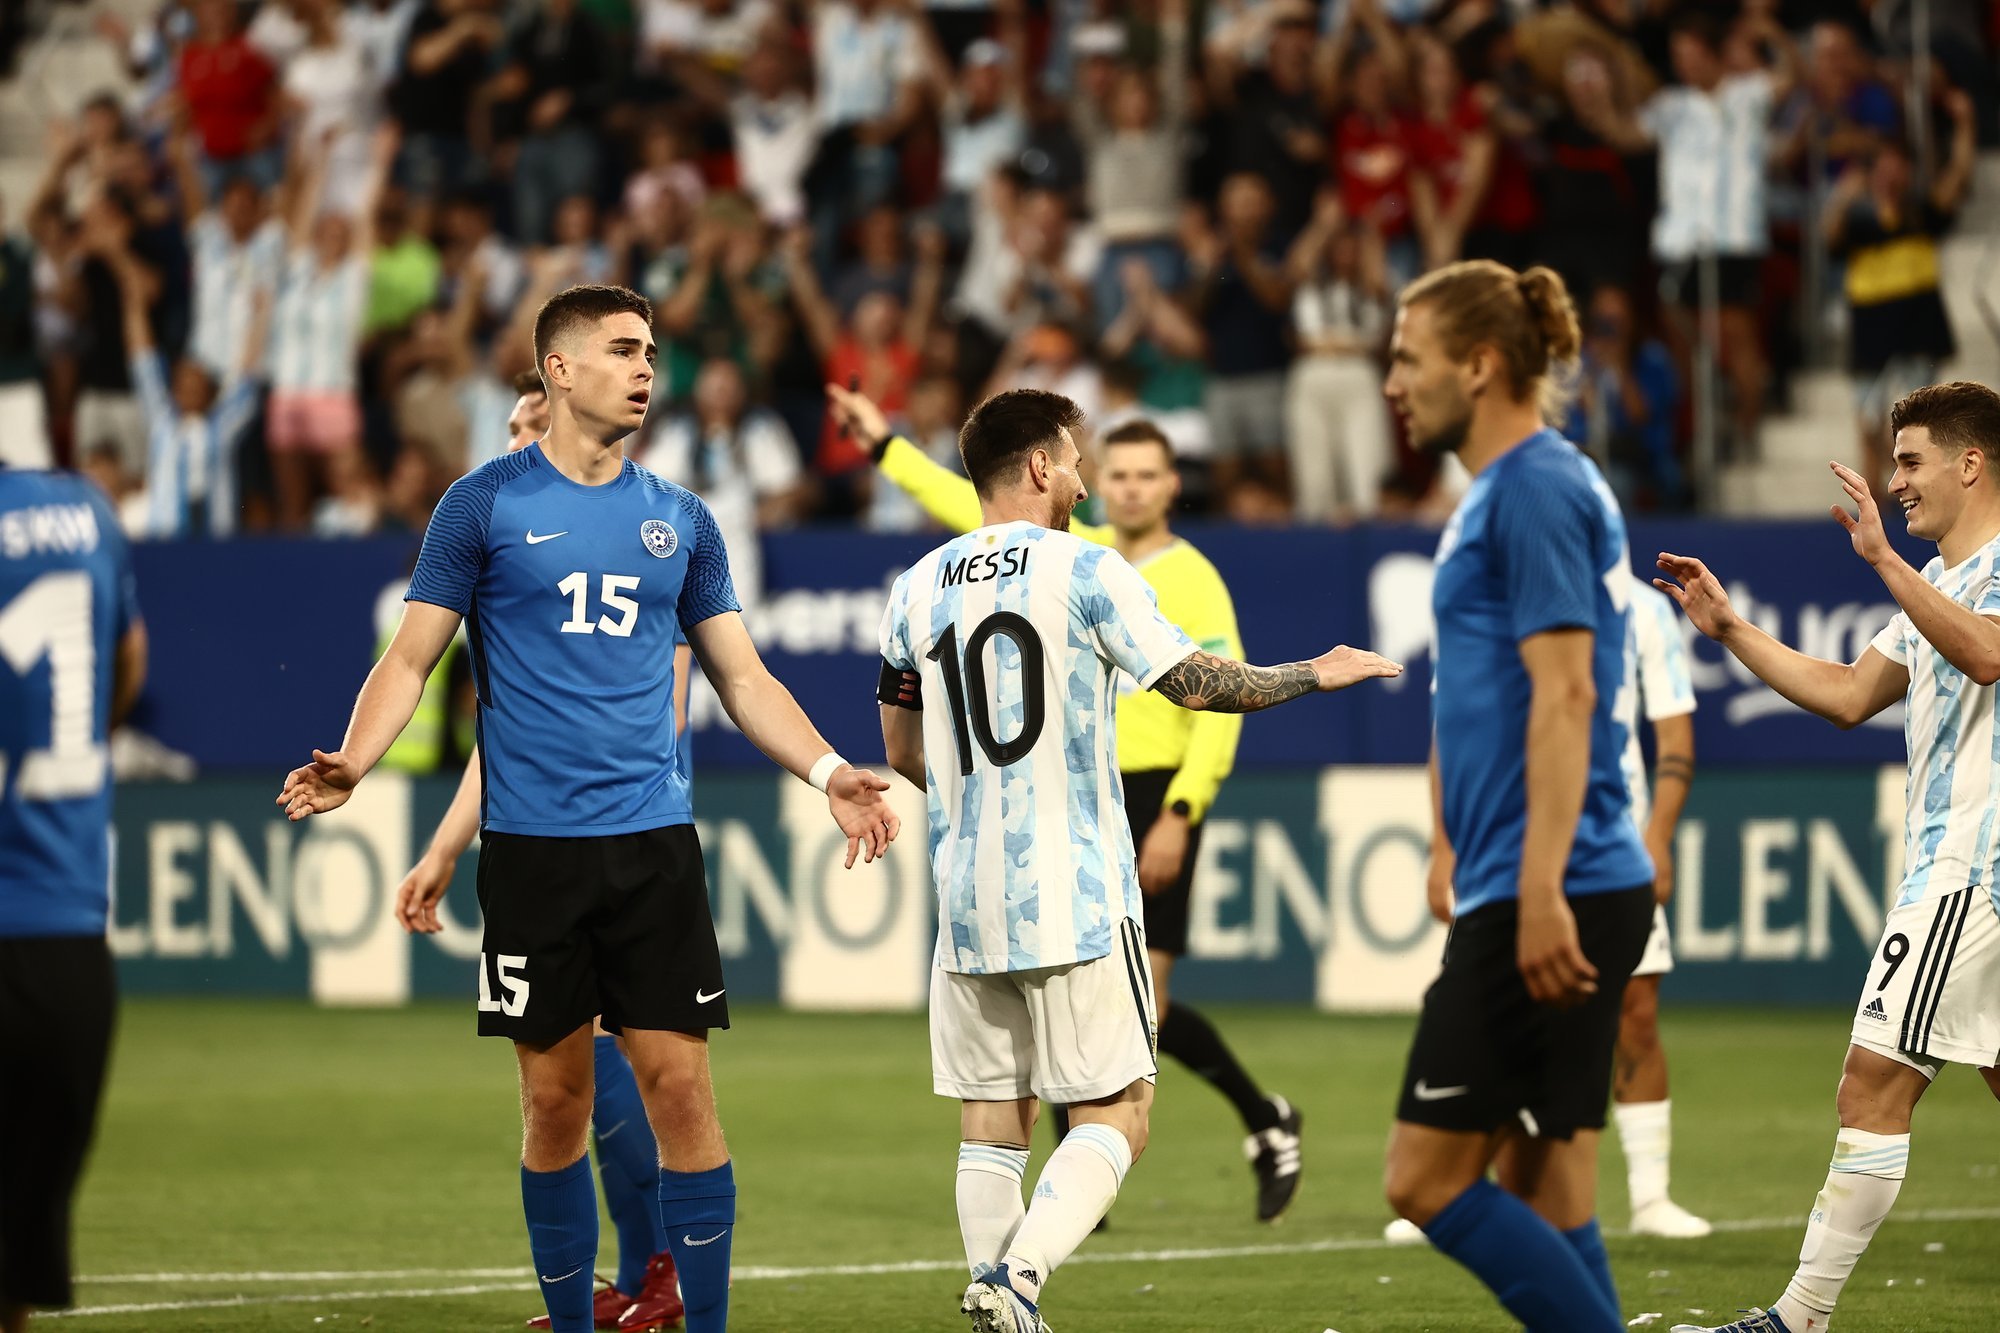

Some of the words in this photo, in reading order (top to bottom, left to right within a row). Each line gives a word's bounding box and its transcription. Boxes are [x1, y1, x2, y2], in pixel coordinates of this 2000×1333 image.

[941, 546, 1029, 589] MESSI
[557, 571, 641, 638] 15
[0, 570, 107, 800] 1
[926, 611, 1045, 776] 10
[477, 951, 530, 1017] 15
[1876, 932, 1911, 992] 9
[1862, 1008, 1888, 1022] adidas
